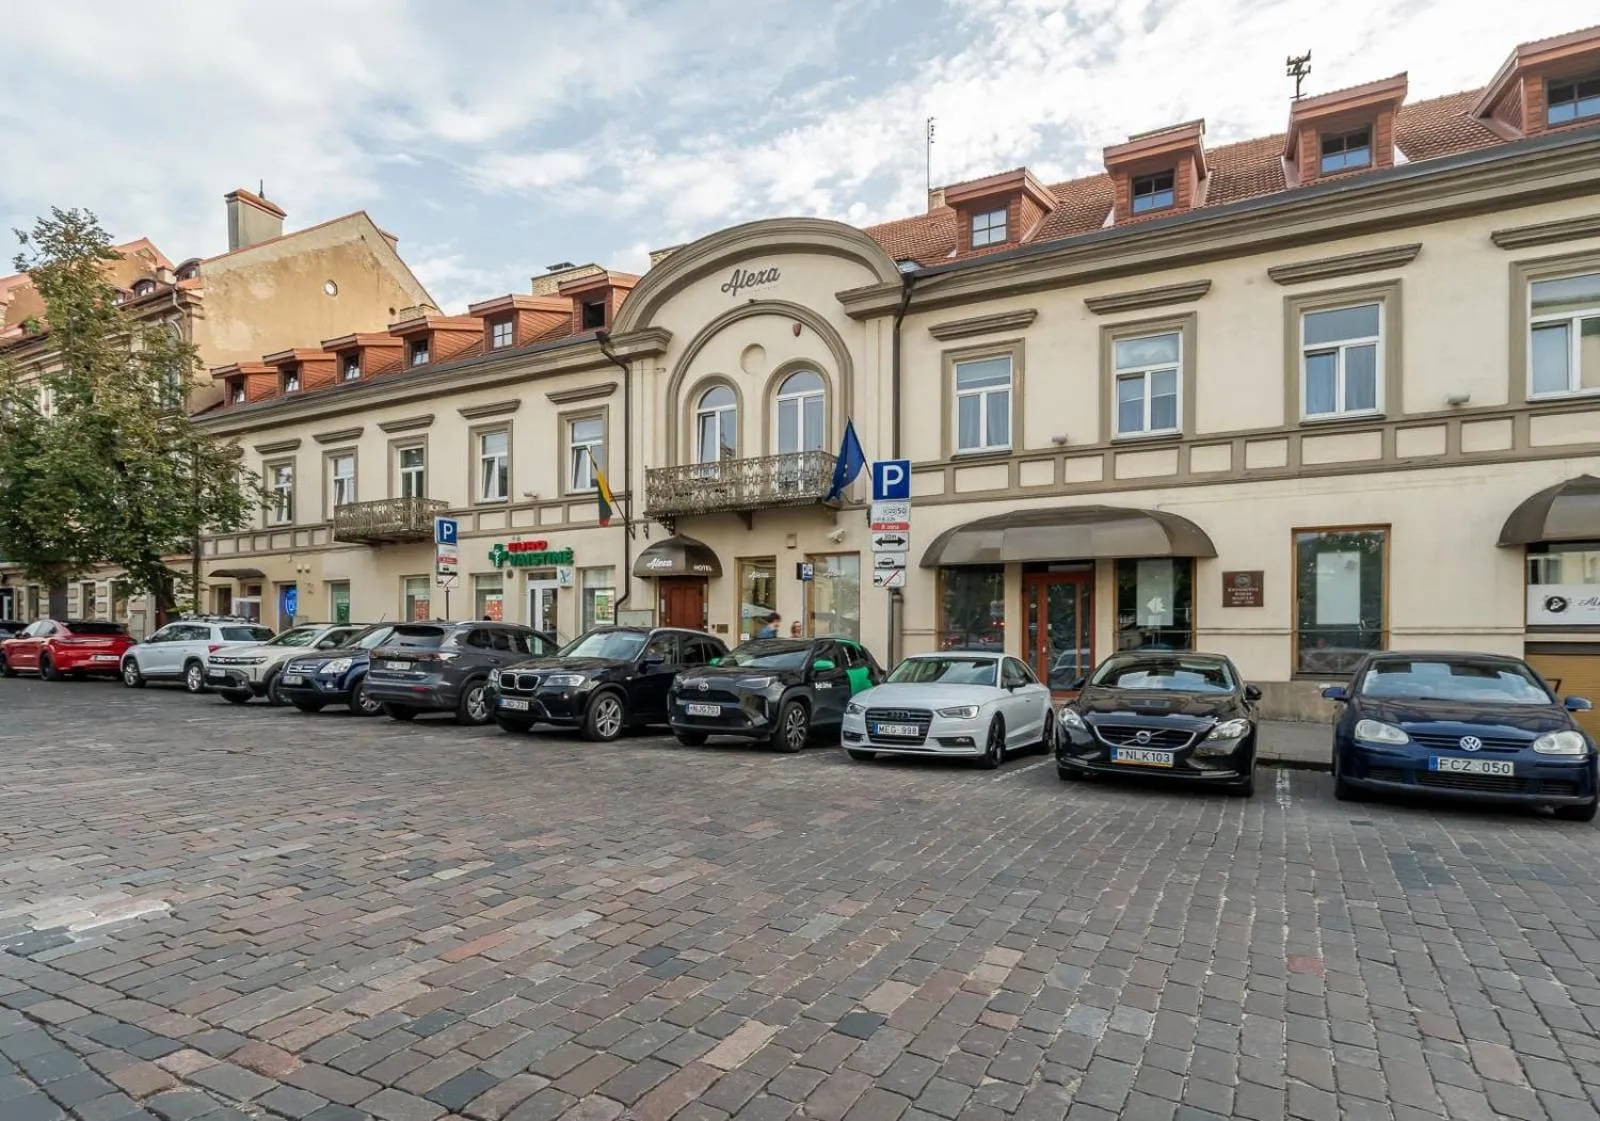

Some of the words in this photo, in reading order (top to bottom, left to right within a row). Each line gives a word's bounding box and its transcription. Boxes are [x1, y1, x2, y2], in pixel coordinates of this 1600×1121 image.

[721, 268, 781, 297] Alexa
[882, 465, 904, 496] P
[443, 523, 453, 539] P
[1440, 759, 1472, 771] FCZ
[1482, 762, 1511, 774] 050
